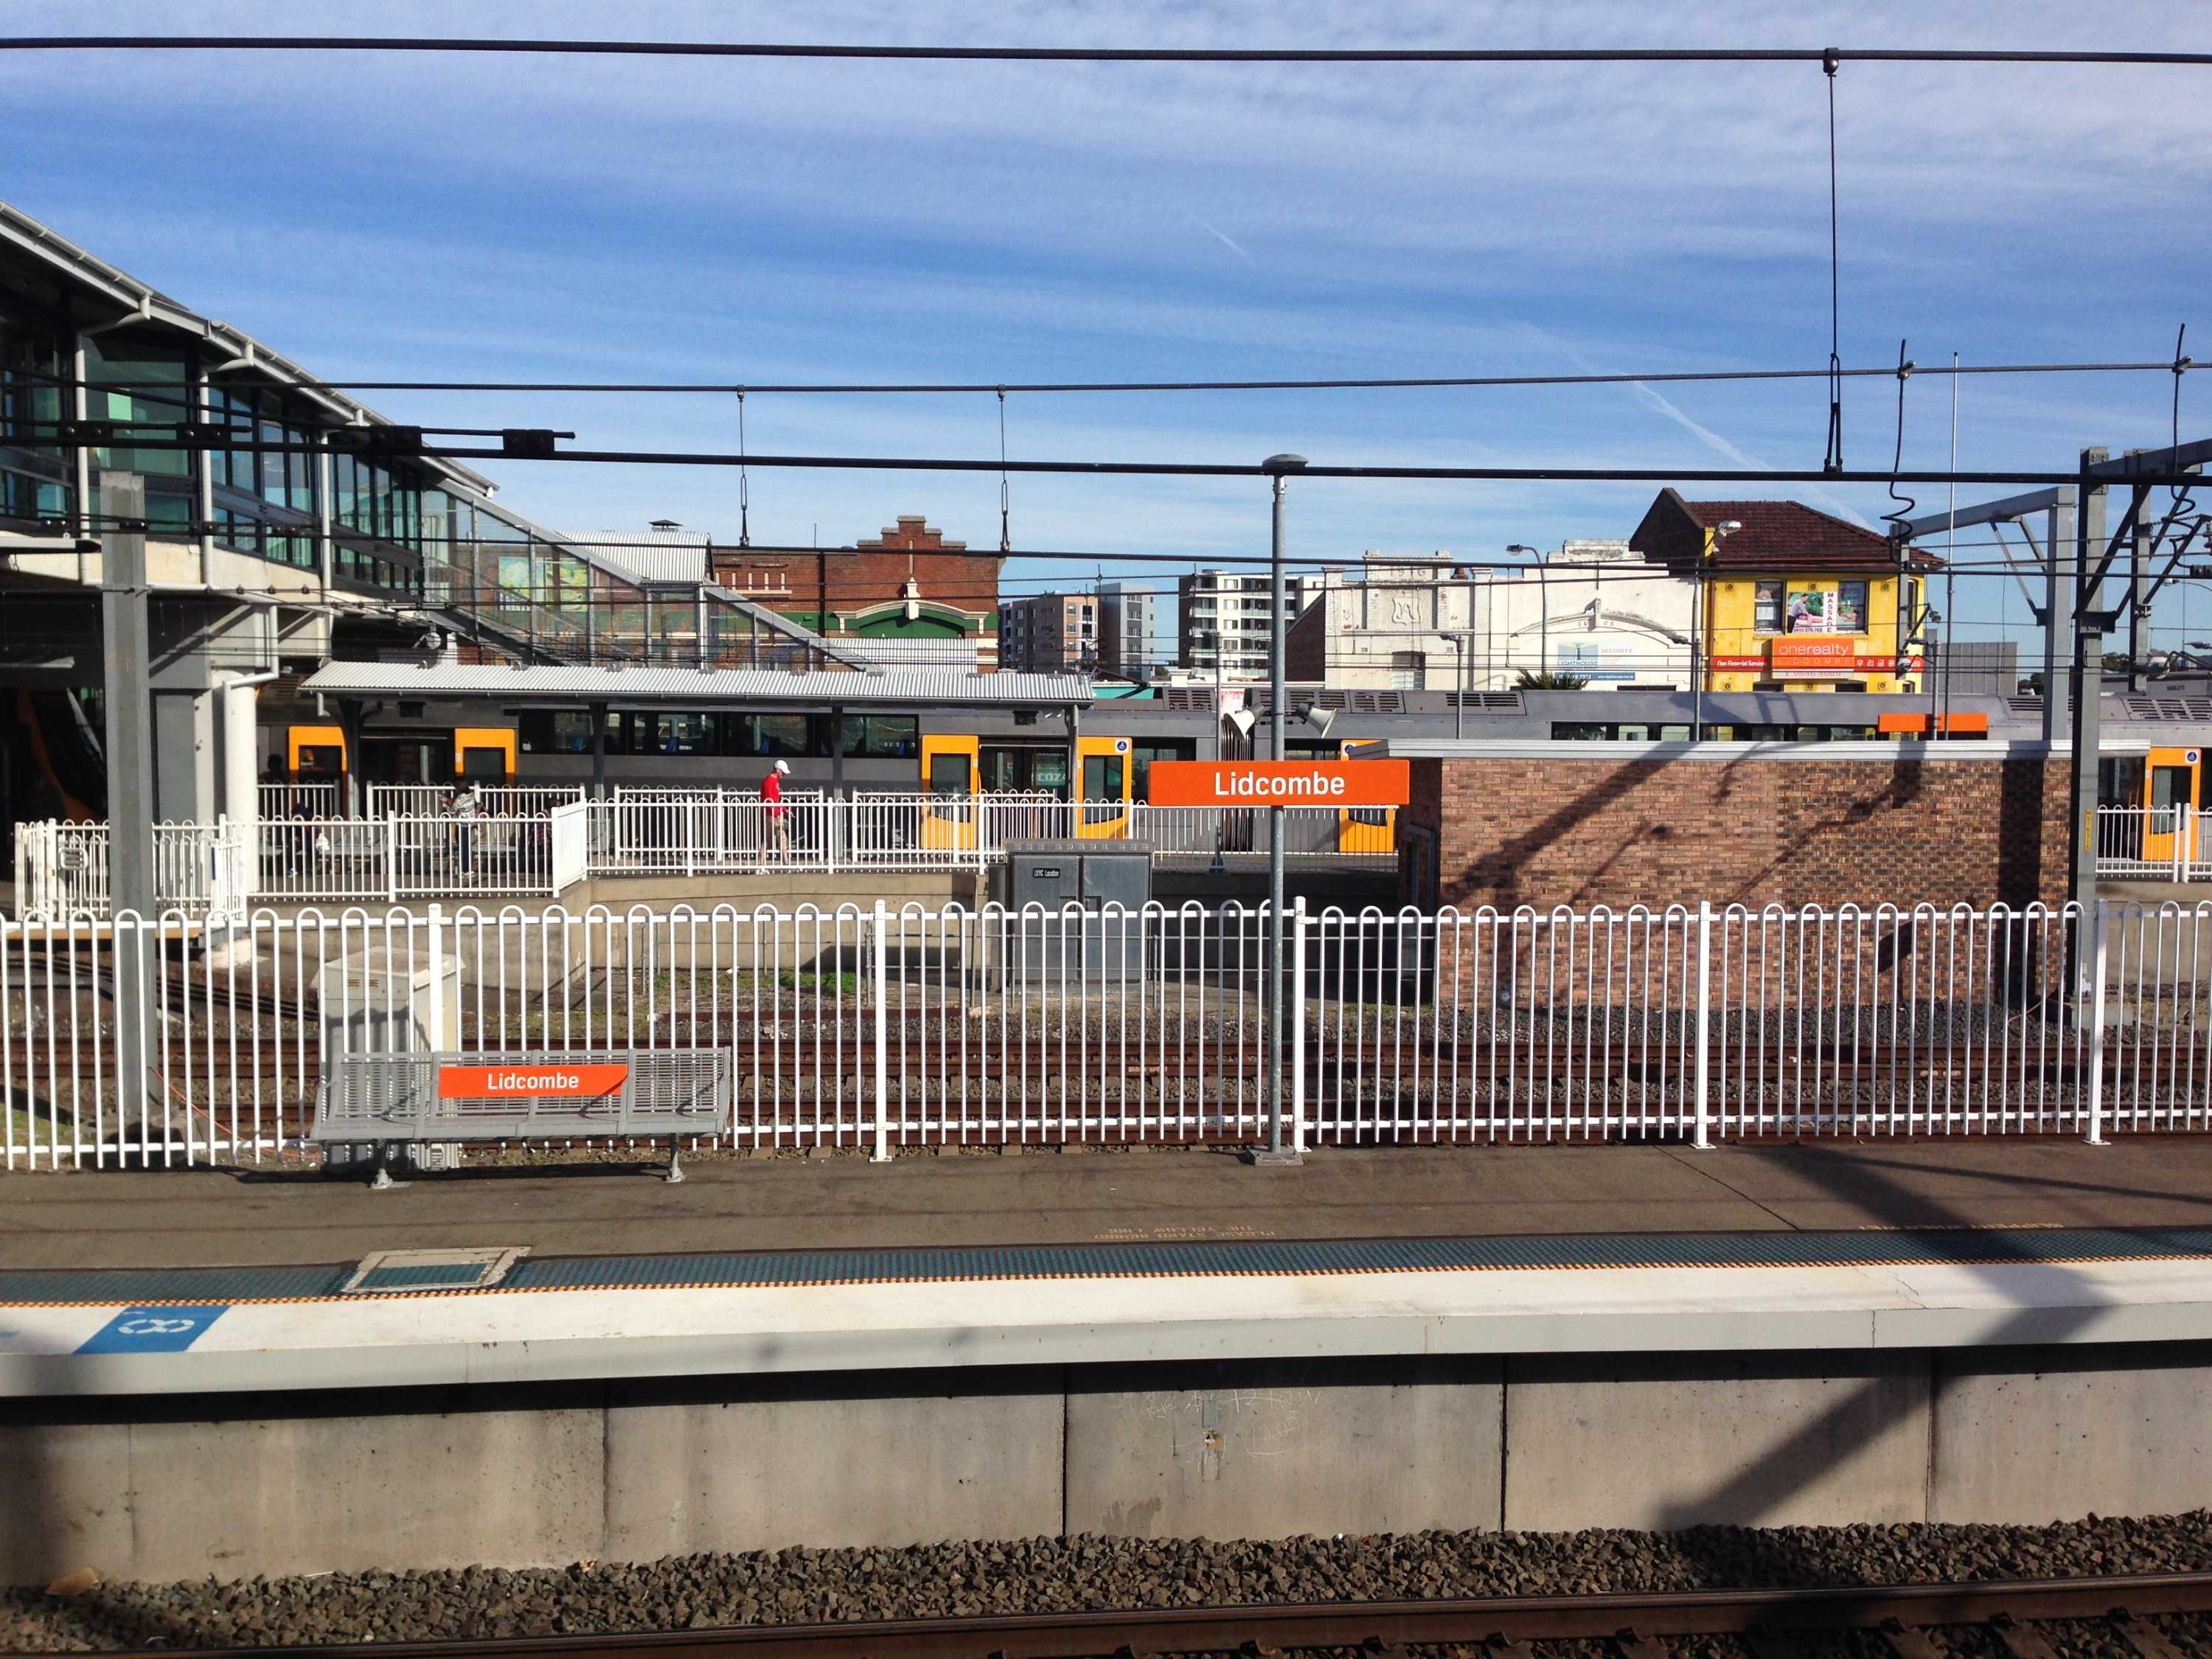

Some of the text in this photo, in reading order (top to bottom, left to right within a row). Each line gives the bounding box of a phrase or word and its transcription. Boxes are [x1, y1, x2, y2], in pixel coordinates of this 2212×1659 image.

[1778, 643, 1850, 656] onerealty
[1215, 771, 1345, 796] Lidcombe
[487, 1073, 580, 1089] Lidcombe
